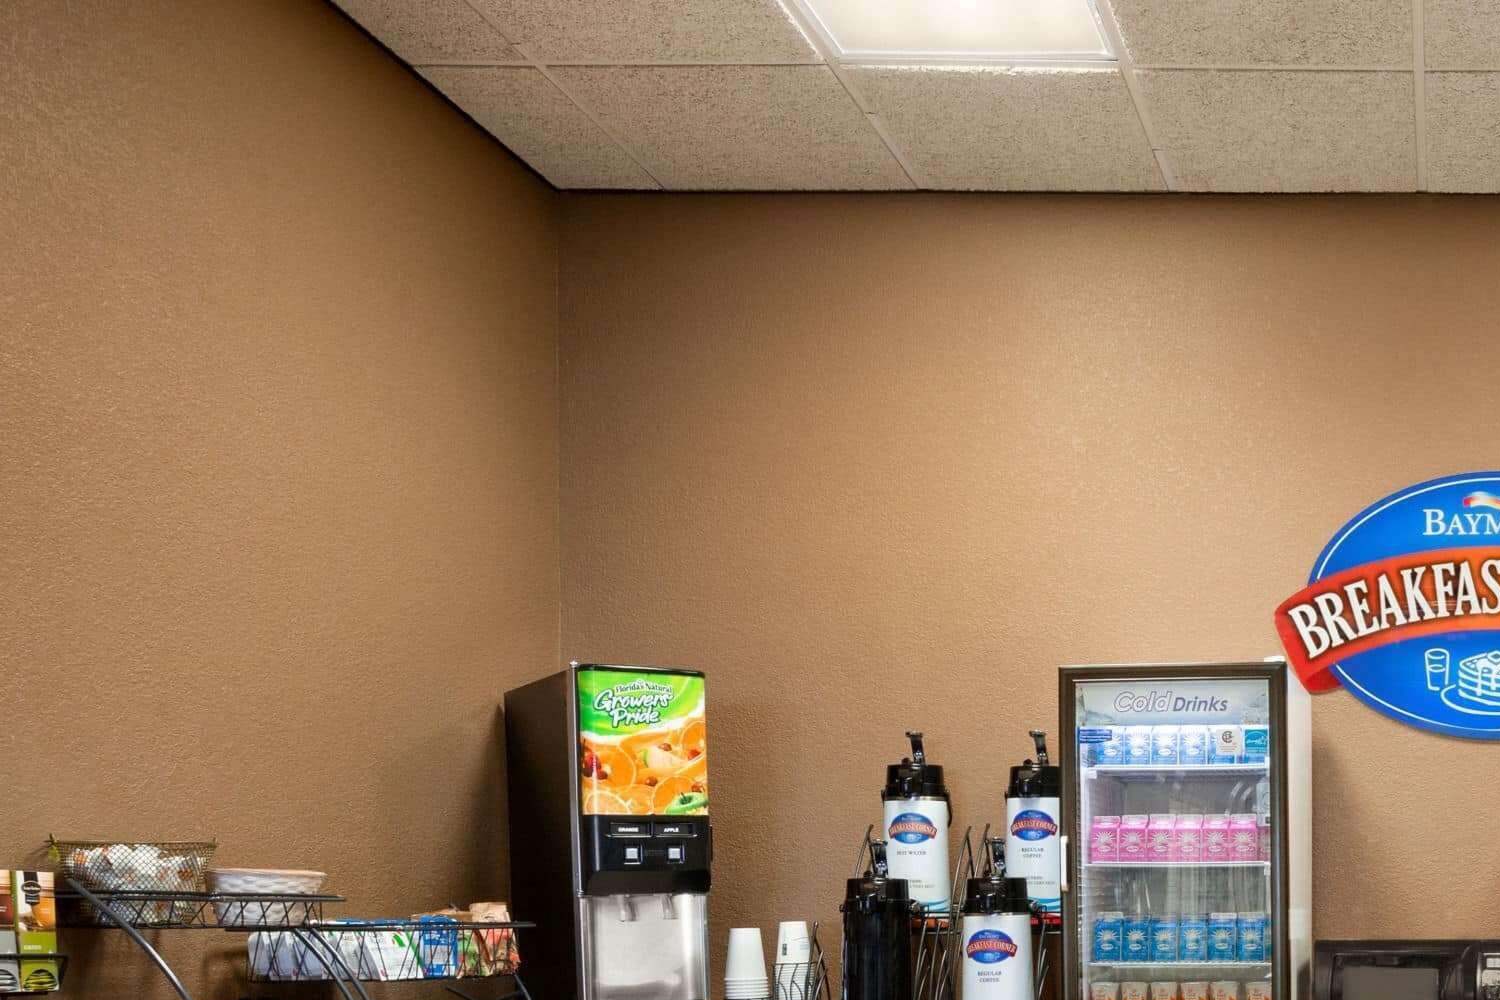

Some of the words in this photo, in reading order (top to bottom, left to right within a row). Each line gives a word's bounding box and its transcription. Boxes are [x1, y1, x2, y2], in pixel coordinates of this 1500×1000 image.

[1114, 690, 1173, 713] Cold
[1172, 696, 1228, 712] Drinks
[609, 706, 661, 728] Pride
